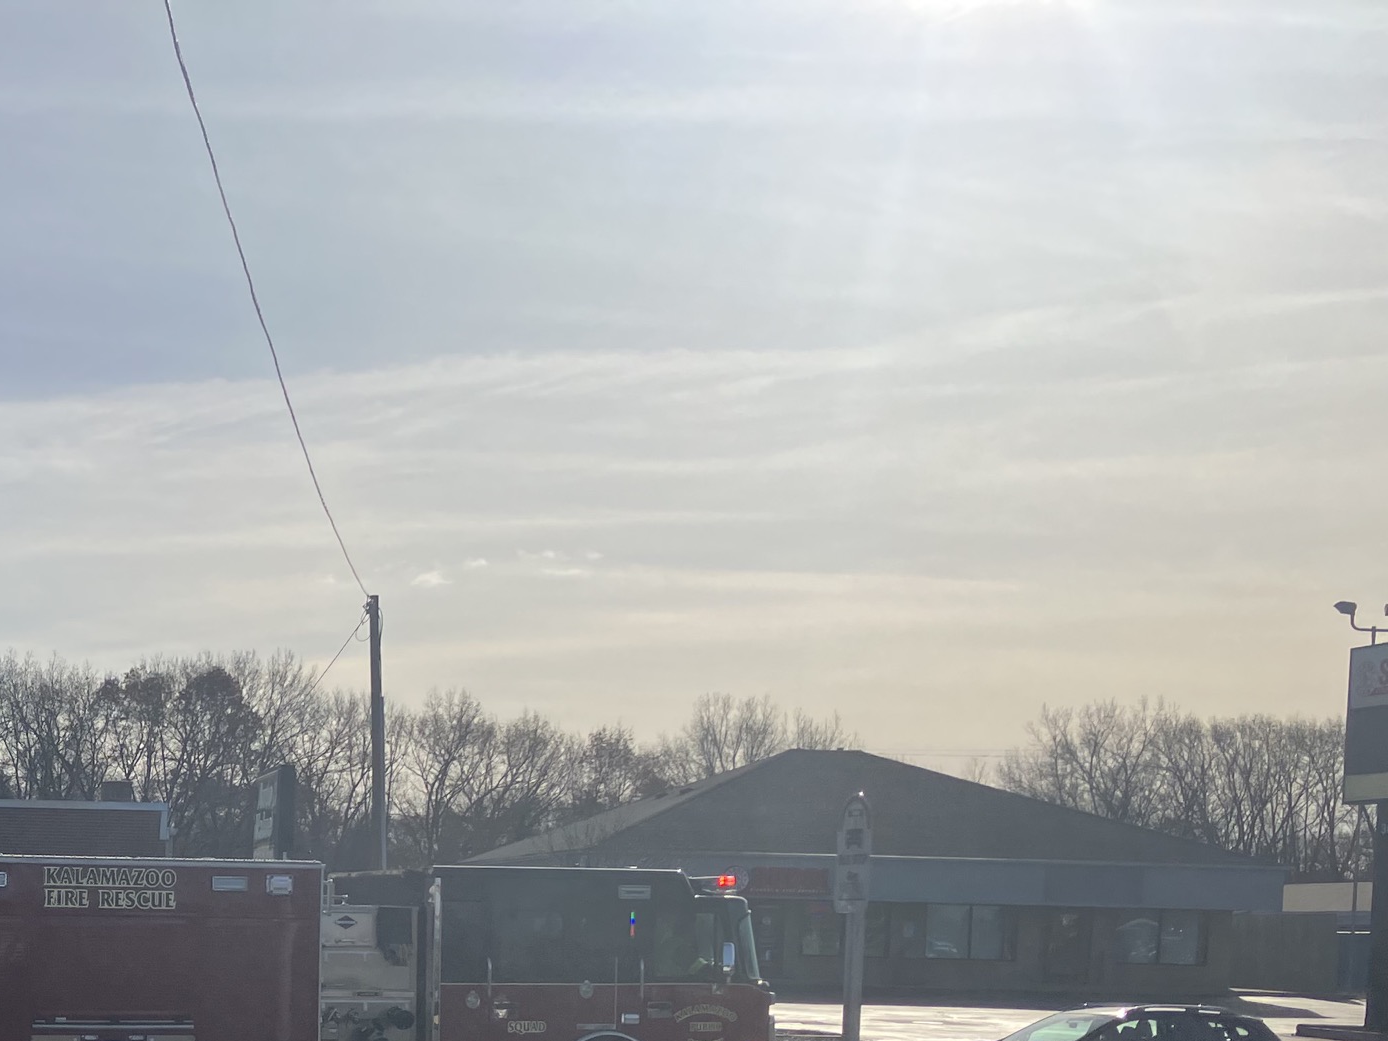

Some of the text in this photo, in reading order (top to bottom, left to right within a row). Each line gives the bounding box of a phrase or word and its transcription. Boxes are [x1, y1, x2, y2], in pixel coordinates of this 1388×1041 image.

[43, 866, 177, 888] KALAMAZOO
[43, 888, 177, 910] FIRE RESCUE
[673, 1003, 738, 1023] KALAMAZOO
[508, 1020, 547, 1035] SQUAD
